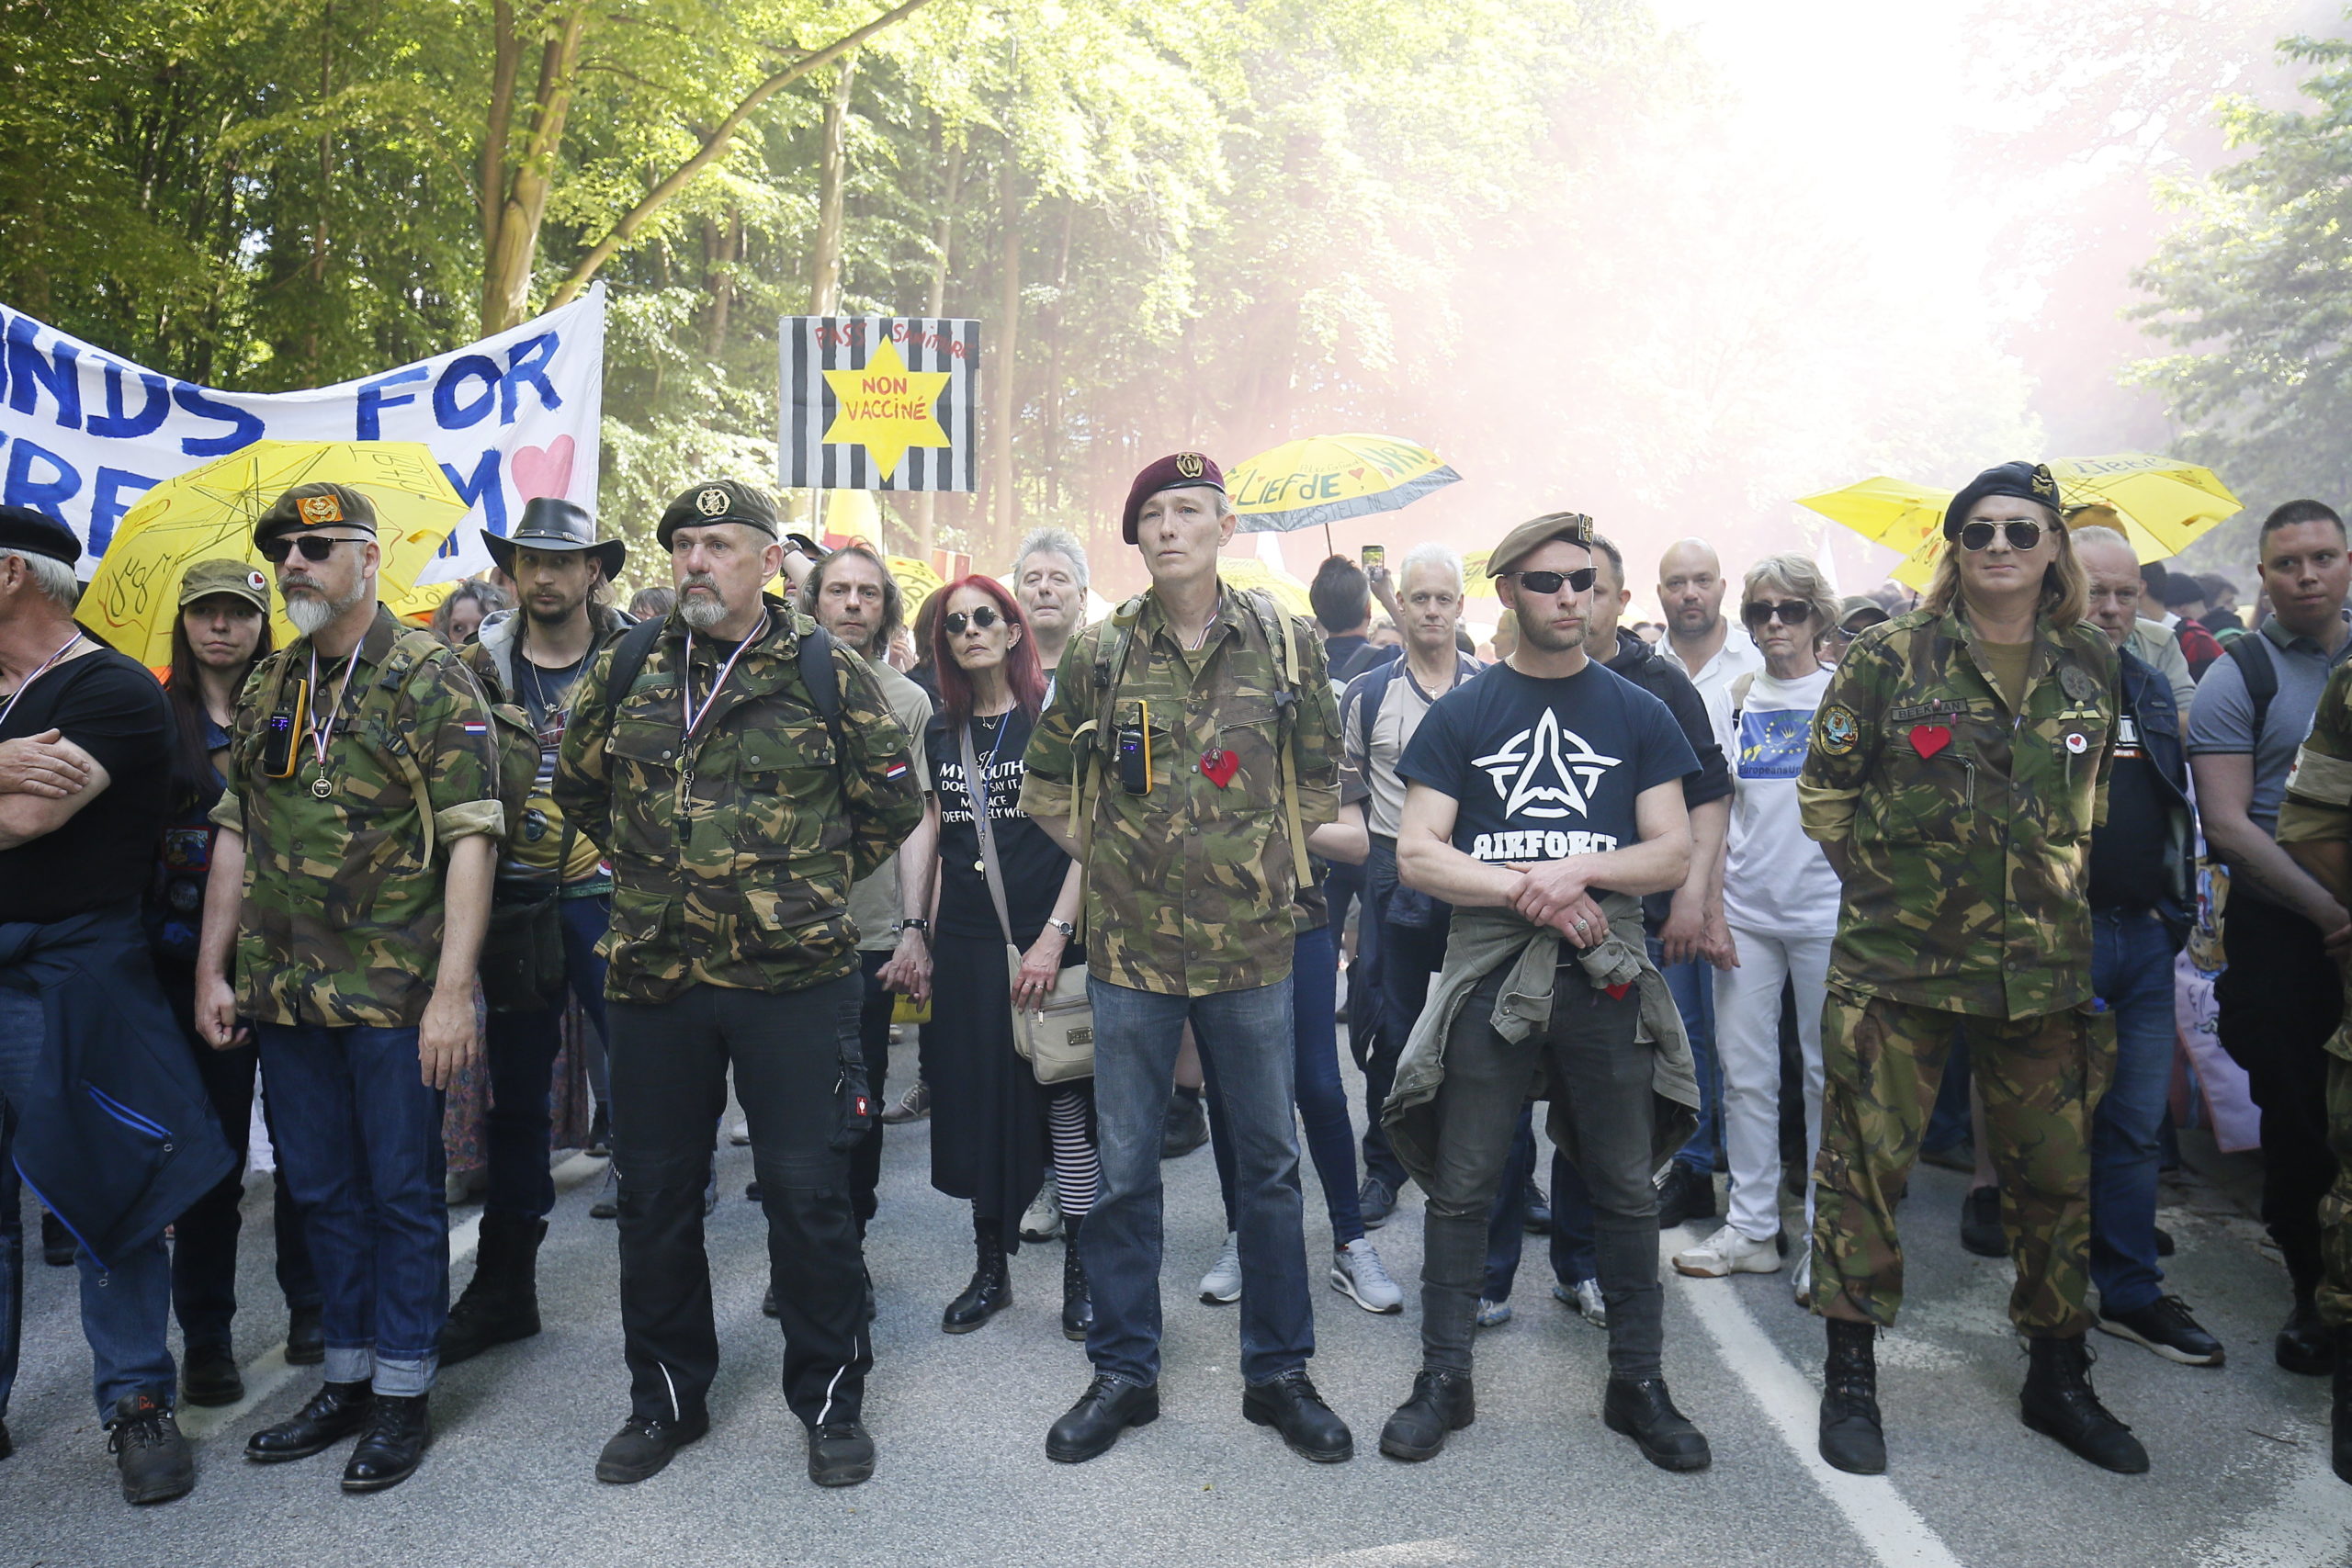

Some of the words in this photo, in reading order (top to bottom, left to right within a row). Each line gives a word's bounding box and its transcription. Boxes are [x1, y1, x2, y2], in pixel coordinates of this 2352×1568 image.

[814, 322, 867, 350] PASS
[0, 310, 266, 457] NDS
[356, 331, 563, 442] FOR
[862, 377, 908, 395] NON
[989, 780, 1005, 793] SAY
[1470, 829, 1618, 861] AIRFORCE
